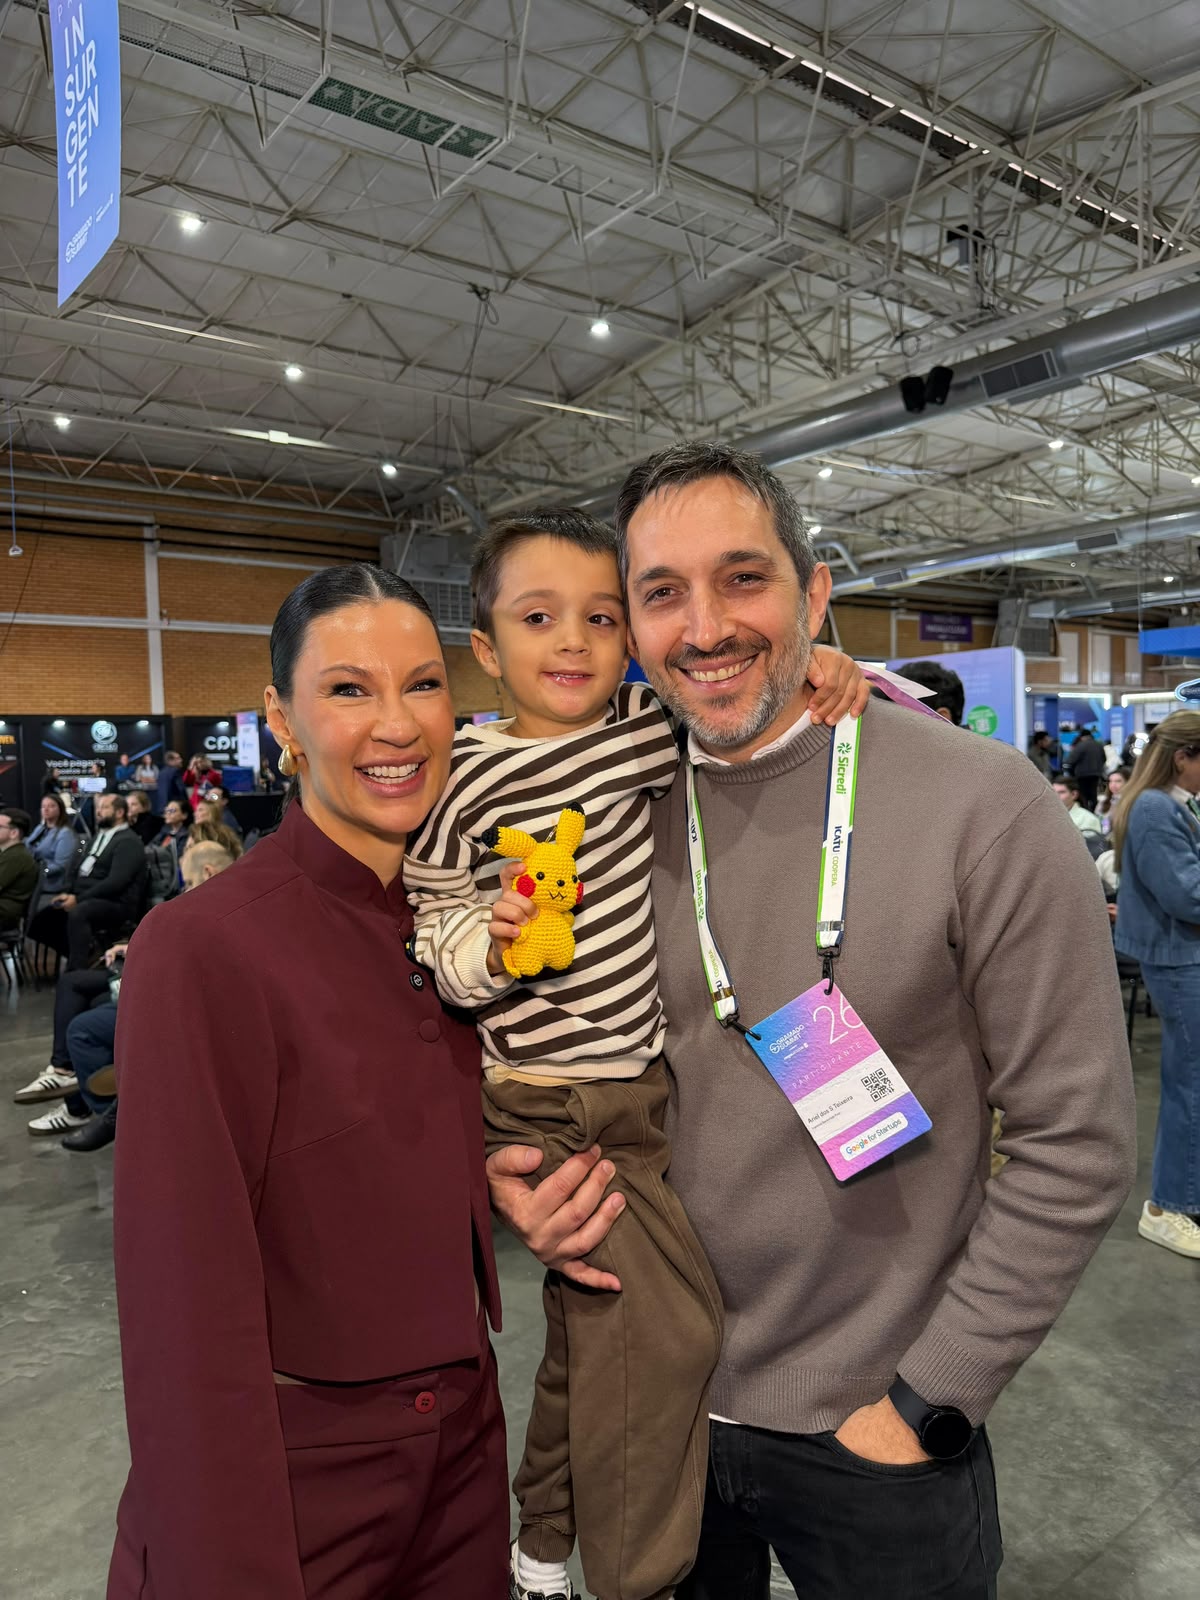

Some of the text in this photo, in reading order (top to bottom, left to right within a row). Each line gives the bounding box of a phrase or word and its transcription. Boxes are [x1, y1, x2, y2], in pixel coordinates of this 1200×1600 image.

[64, 3, 84, 68] IN
[65, 40, 97, 117] SUR
[65, 85, 98, 164] GEN
[67, 149, 88, 208] TE
[835, 756, 849, 795] Sicredi
[831, 825, 842, 887] ICATU COOPERA
[695, 869, 704, 907] Sicredi
[813, 993, 863, 1045] 26
[791, 1041, 862, 1089] PARTICIPANTE
[845, 1119, 902, 1155] Google for Startups
